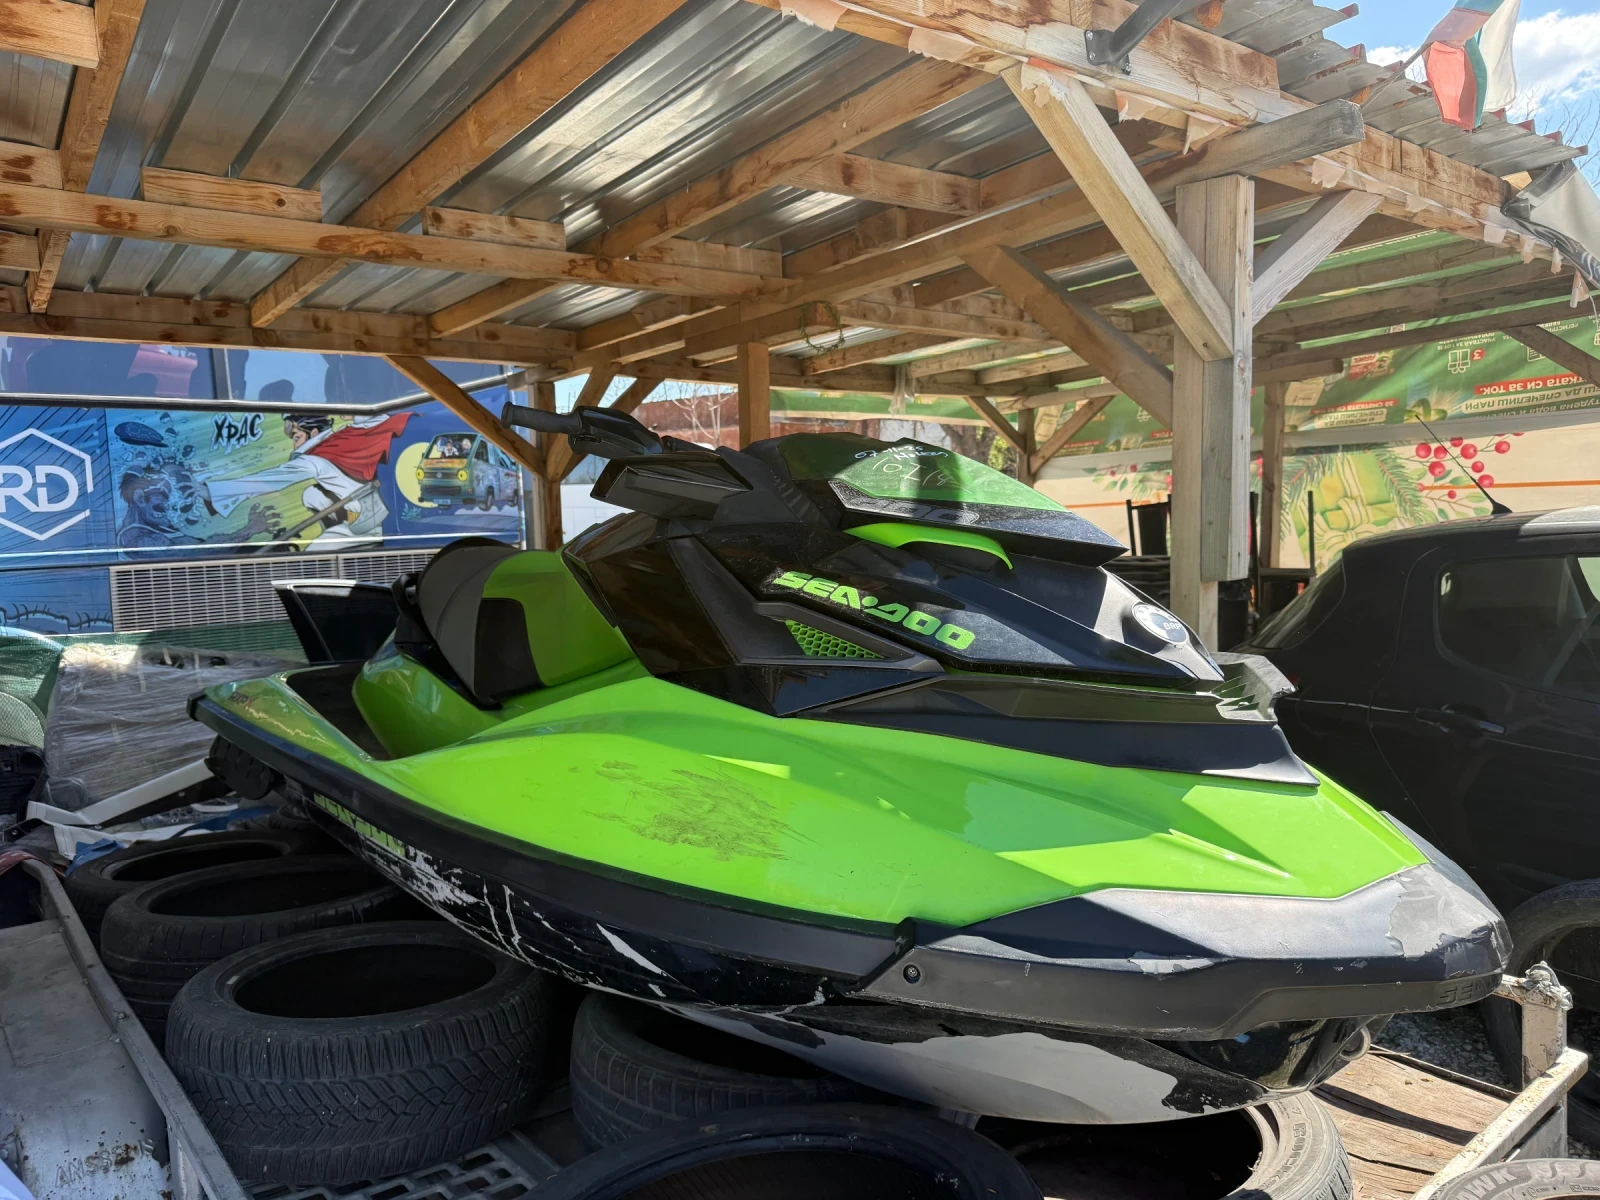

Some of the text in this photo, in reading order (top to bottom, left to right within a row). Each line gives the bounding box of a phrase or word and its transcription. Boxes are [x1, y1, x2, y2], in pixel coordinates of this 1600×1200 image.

[1473, 349, 1483, 360] 3
[1546, 375, 1586, 387] тката
[1565, 388, 1582, 396] ДА
[1497, 391, 1562, 407] СПЕЧЕЛИШ
[1465, 400, 1495, 411] ПАРИ
[1162, 622, 1182, 630] BRP
